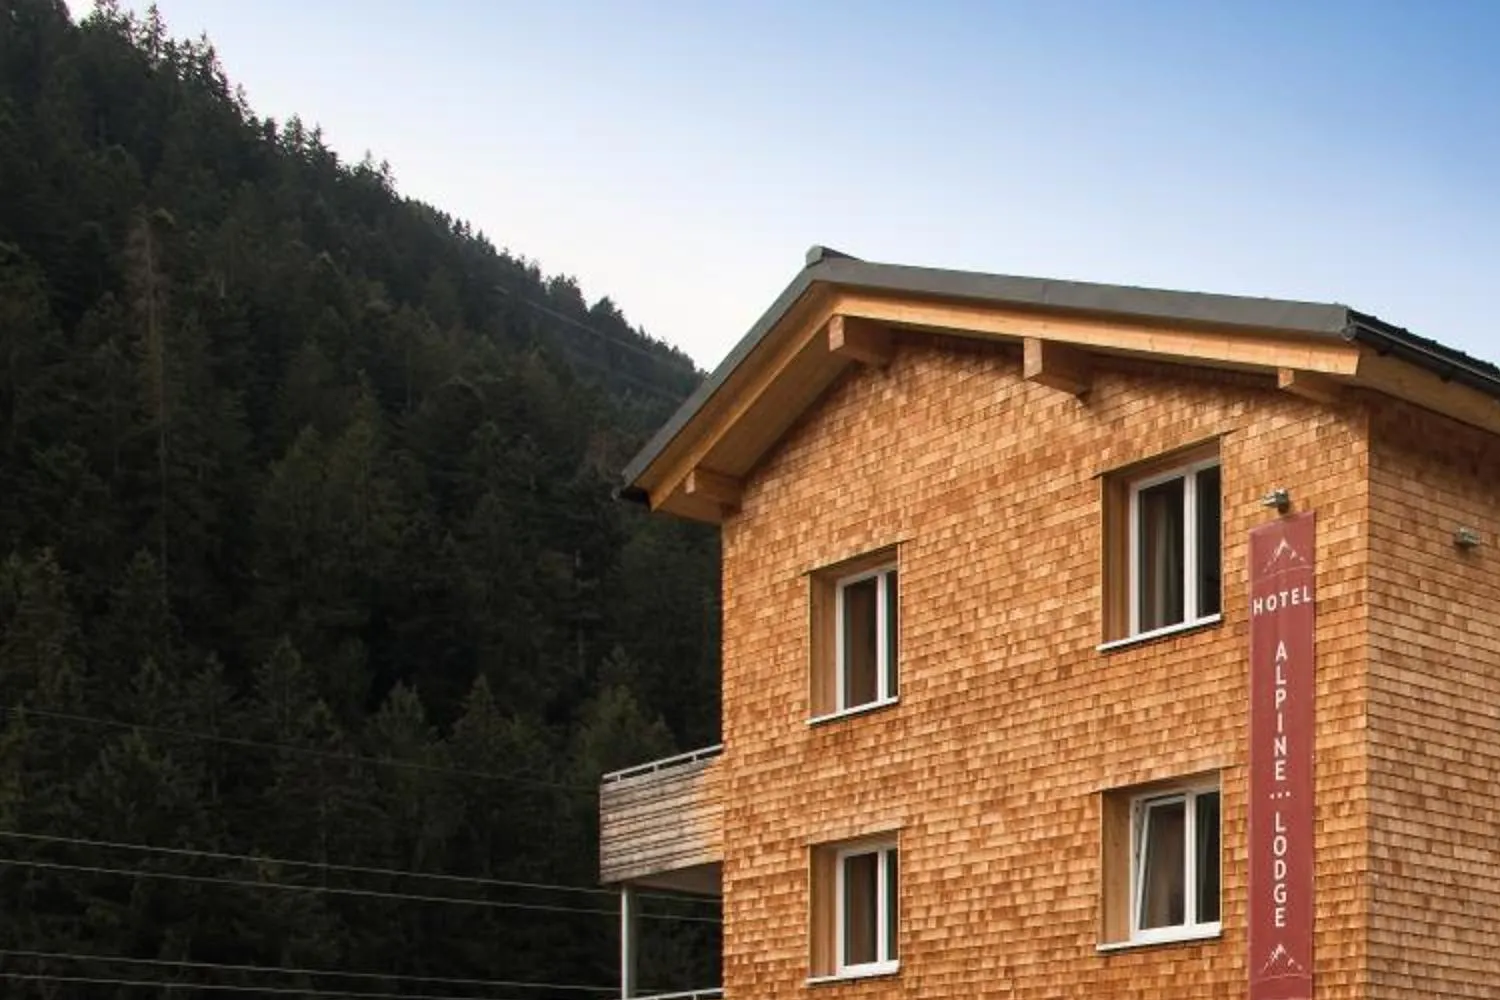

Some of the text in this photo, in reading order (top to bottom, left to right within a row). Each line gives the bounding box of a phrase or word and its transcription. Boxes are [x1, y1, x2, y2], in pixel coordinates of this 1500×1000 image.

[1253, 585, 1311, 615] HOTEL
[1273, 640, 1288, 927] ALPINE LODGE
